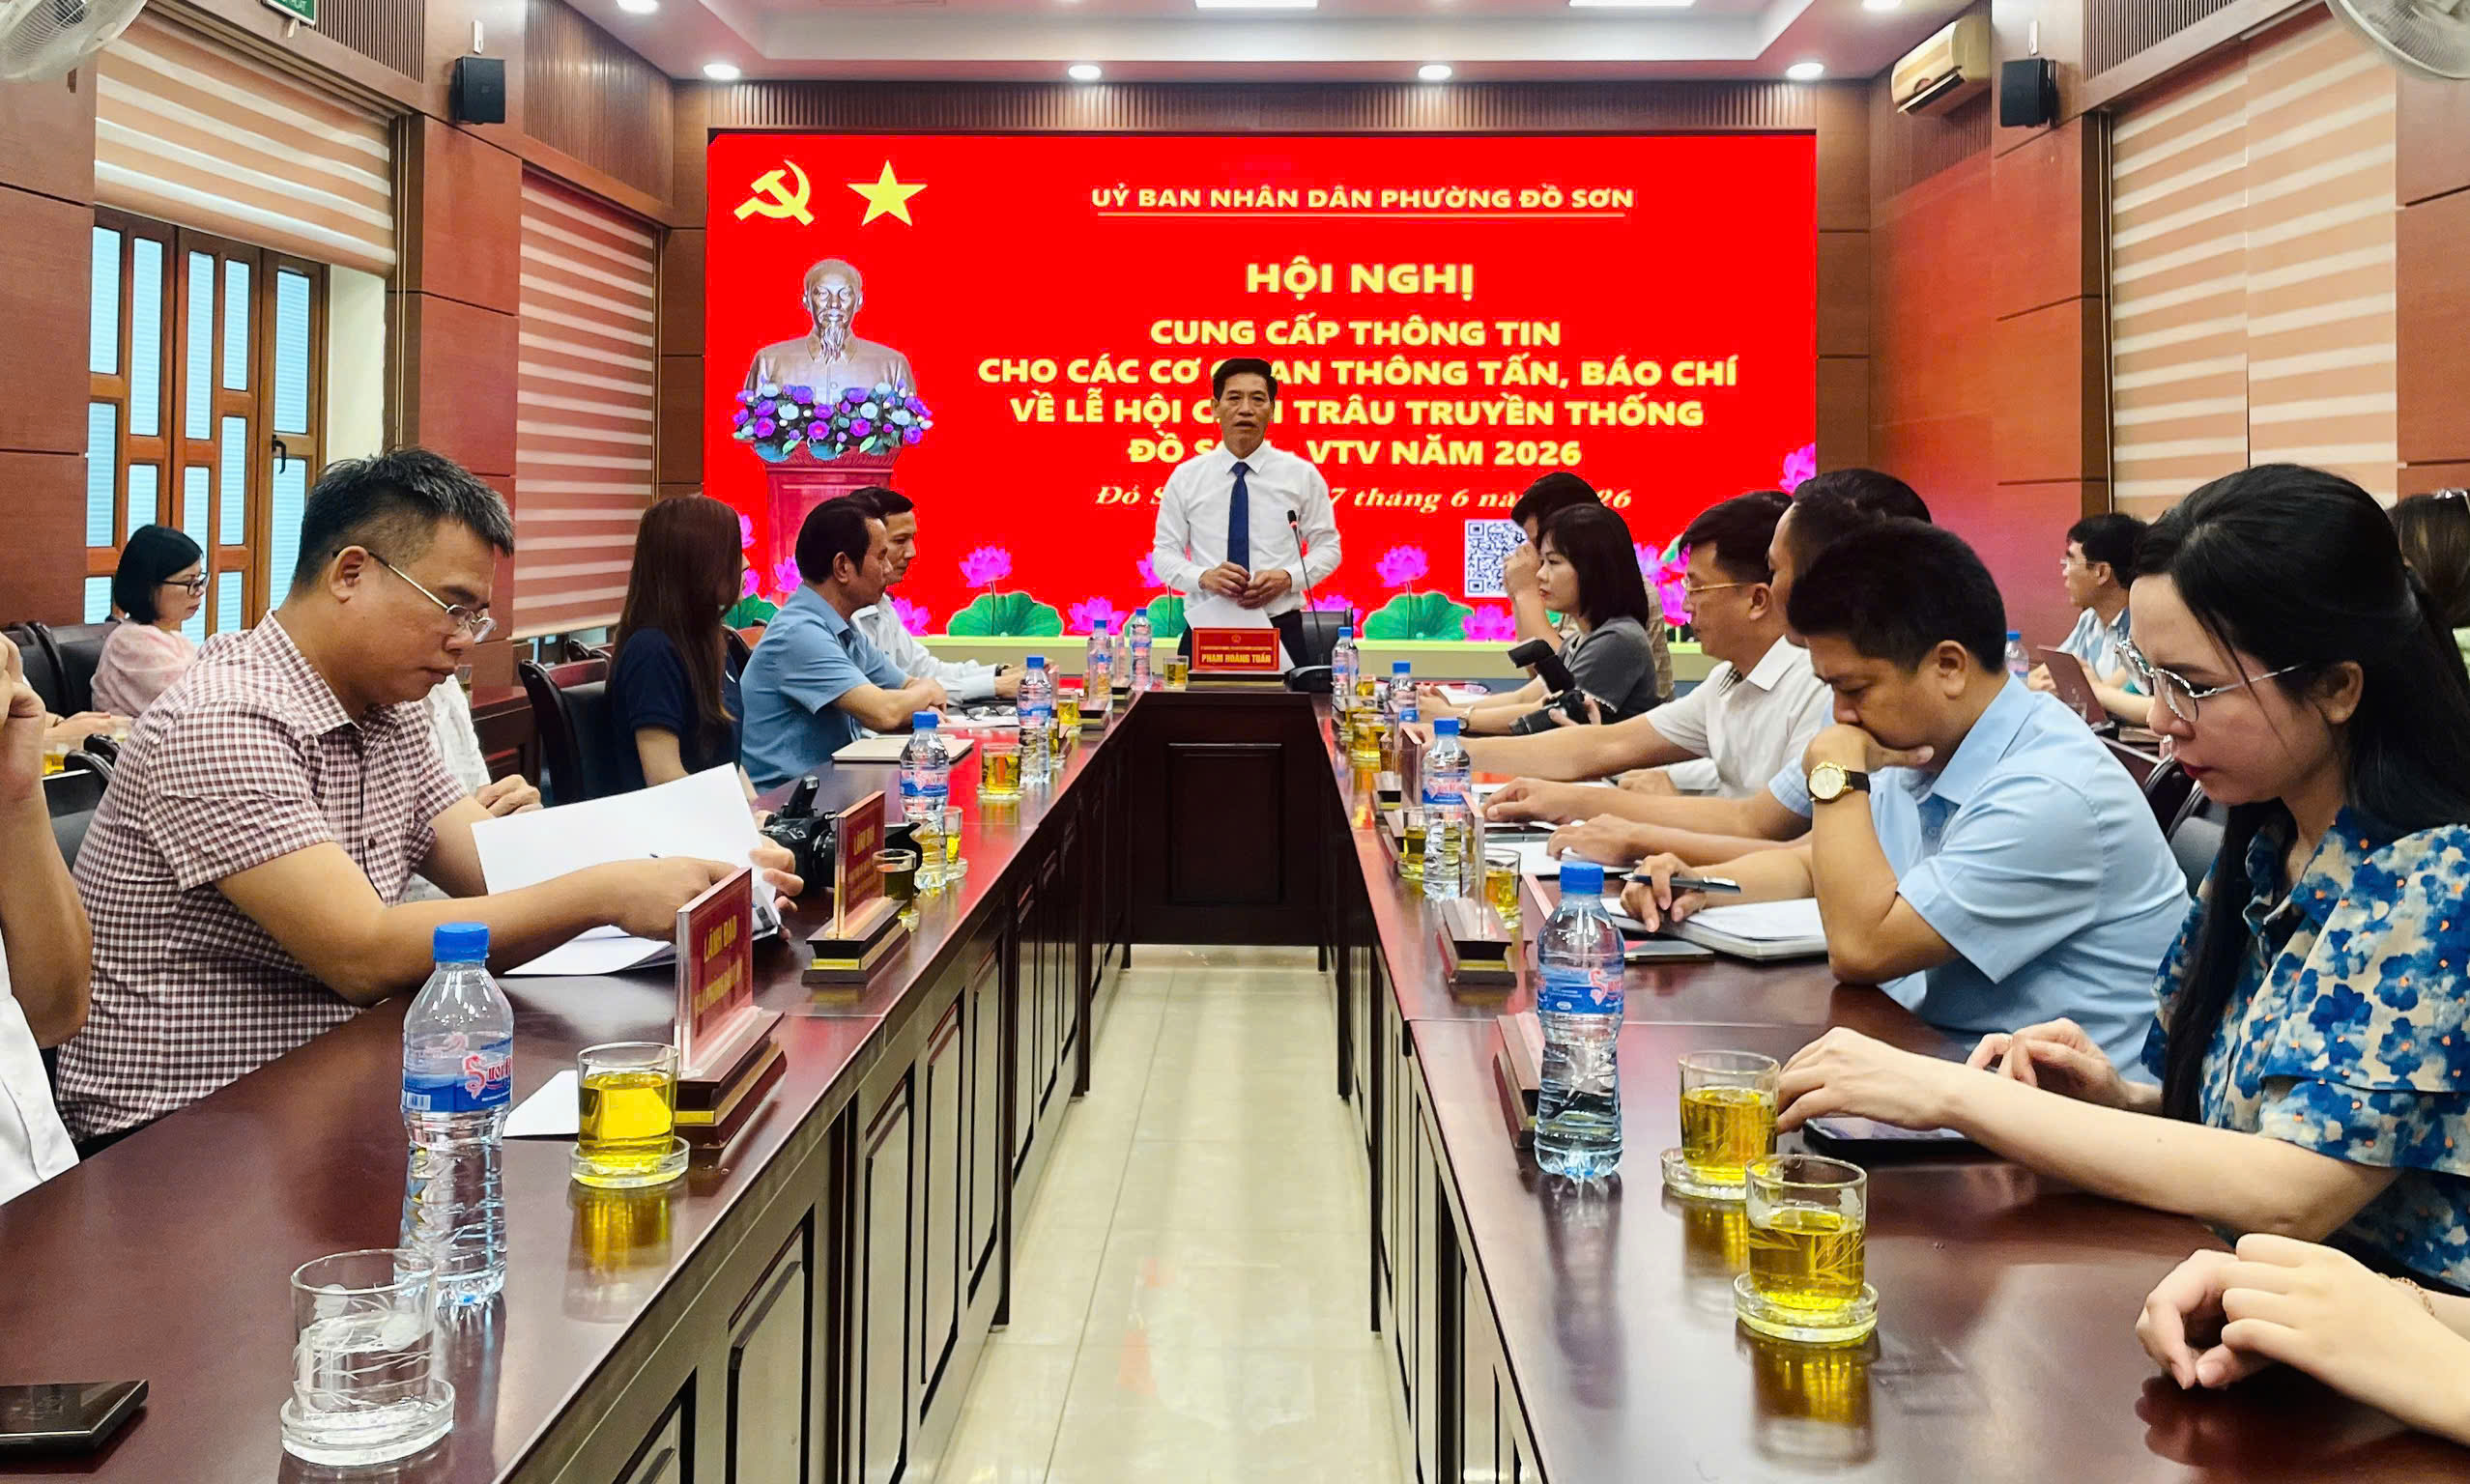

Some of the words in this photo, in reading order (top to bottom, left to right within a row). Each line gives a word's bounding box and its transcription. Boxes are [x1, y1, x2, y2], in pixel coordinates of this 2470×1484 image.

[1138, 189, 1200, 207] BAN
[1211, 185, 1298, 208] NHÂN
[1307, 185, 1372, 208] DÂN
[1381, 185, 1511, 208] PHƯỜNG
[1519, 184, 1563, 208] ĐỒ
[1572, 187, 1633, 208] SƠN
[1247, 255, 1333, 300] HỘI
[1351, 264, 1474, 301] NGHỊ
[1151, 320, 1255, 345] CUNG
[1266, 312, 1339, 345] CẤP
[1349, 315, 1485, 346] THÔNG
[1495, 321, 1560, 346] TIN
[978, 358, 1057, 383] CHO
[1067, 354, 1139, 384] CÁC
[1149, 357, 1201, 384] CƠ
[1211, 359, 1320, 385] AN
[1331, 354, 1468, 385] THÔNG
[1478, 353, 1568, 388] TẤN,
[1581, 355, 1661, 386] BÁO
[1671, 355, 1738, 386] CHÍ
[1010, 389, 1055, 422] VỀ
[1067, 387, 1104, 422] LỄ
[1115, 392, 1181, 428] HỘI
[1192, 398, 1282, 423] CI
[1293, 393, 1394, 425] TRÂU
[1405, 392, 1554, 425] TRUYỀN
[1565, 391, 1704, 426] THỐNG
[1128, 431, 1184, 464] ĐỒ
[1307, 441, 1381, 465] VTV
[1392, 434, 1483, 466] NĂM
[1494, 441, 1582, 466] 2026
[1450, 489, 1470, 507] 6
